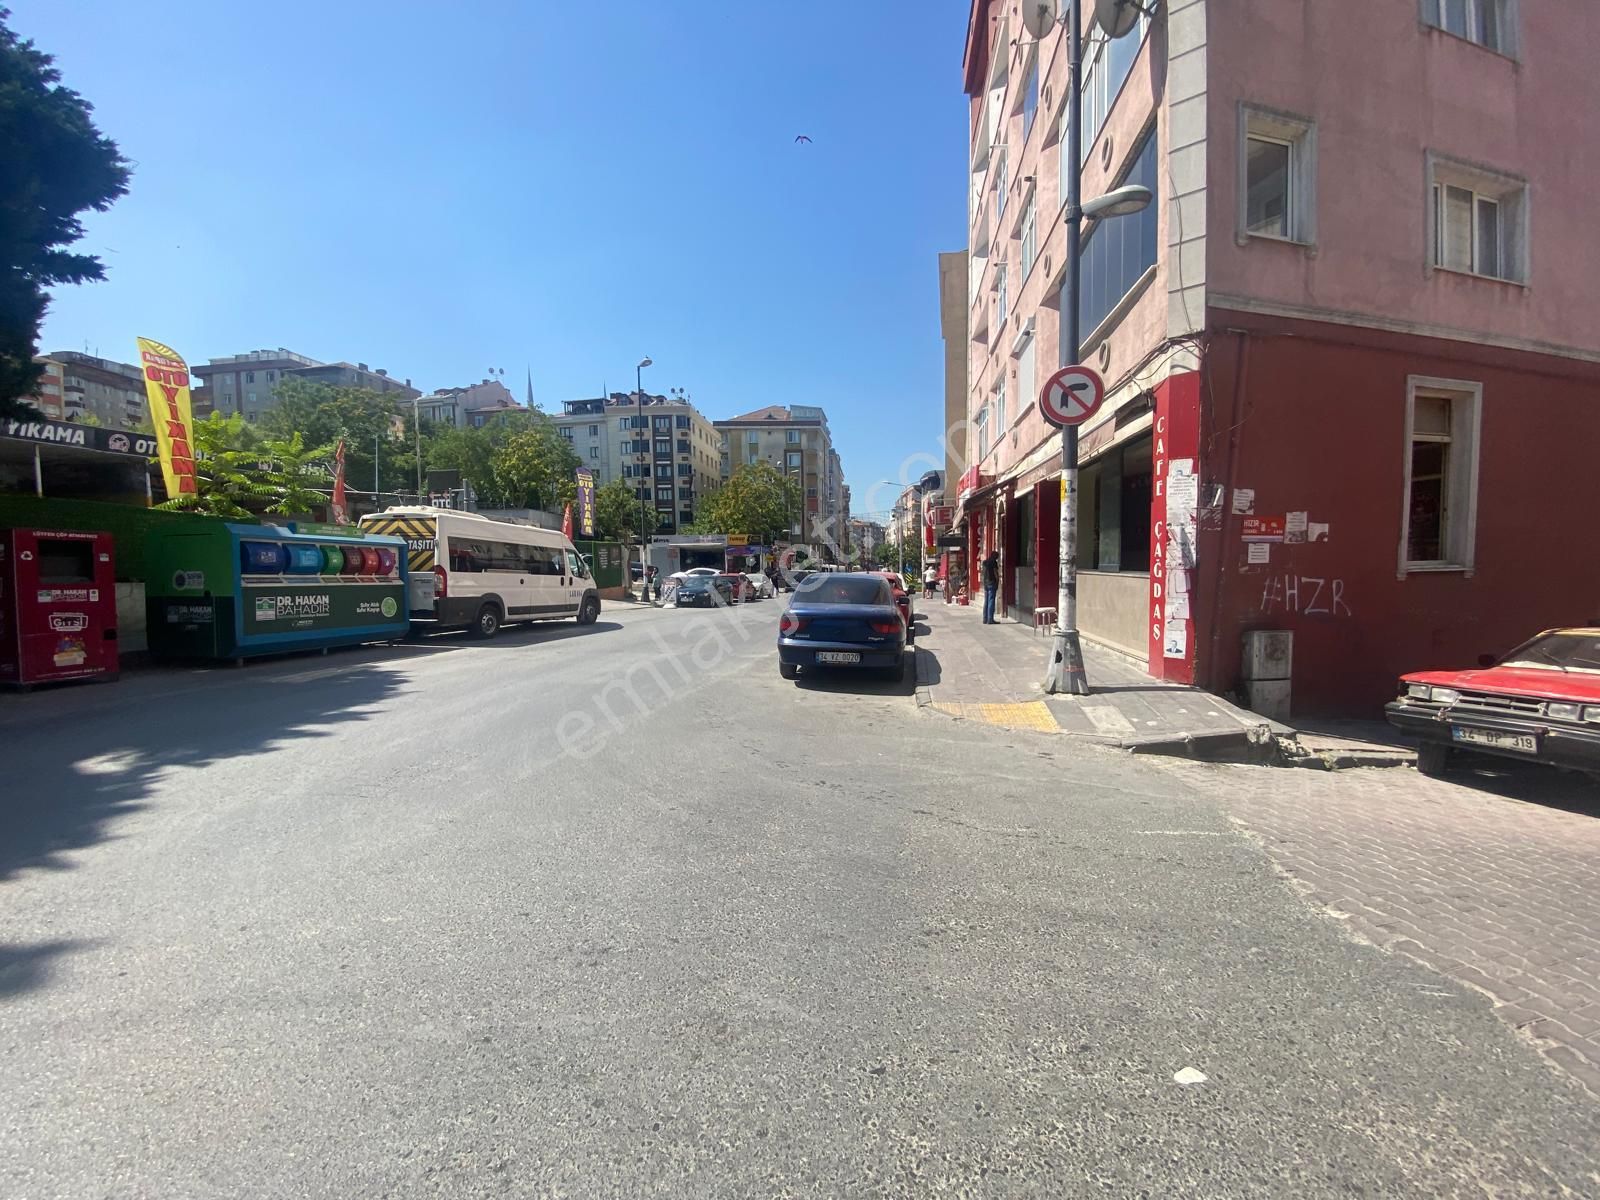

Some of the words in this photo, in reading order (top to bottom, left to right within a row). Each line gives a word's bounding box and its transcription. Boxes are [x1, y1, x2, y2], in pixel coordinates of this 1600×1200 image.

[146, 366, 189, 386] OTO
[8, 421, 85, 445] YIKAMA
[162, 386, 196, 493] YIKAMA
[1155, 415, 1166, 497] CAFE
[579, 480, 593, 488] OTO
[408, 539, 434, 551] TAŞITI
[1152, 520, 1164, 641] ÇAĞDAŞ
[277, 596, 294, 606] DR.
[295, 595, 329, 606] HAKAN
[1260, 574, 1352, 616] #HZR
[277, 604, 330, 616] BAHADIR
[1460, 728, 1475, 740] 34
[1512, 736, 1533, 748] 319
